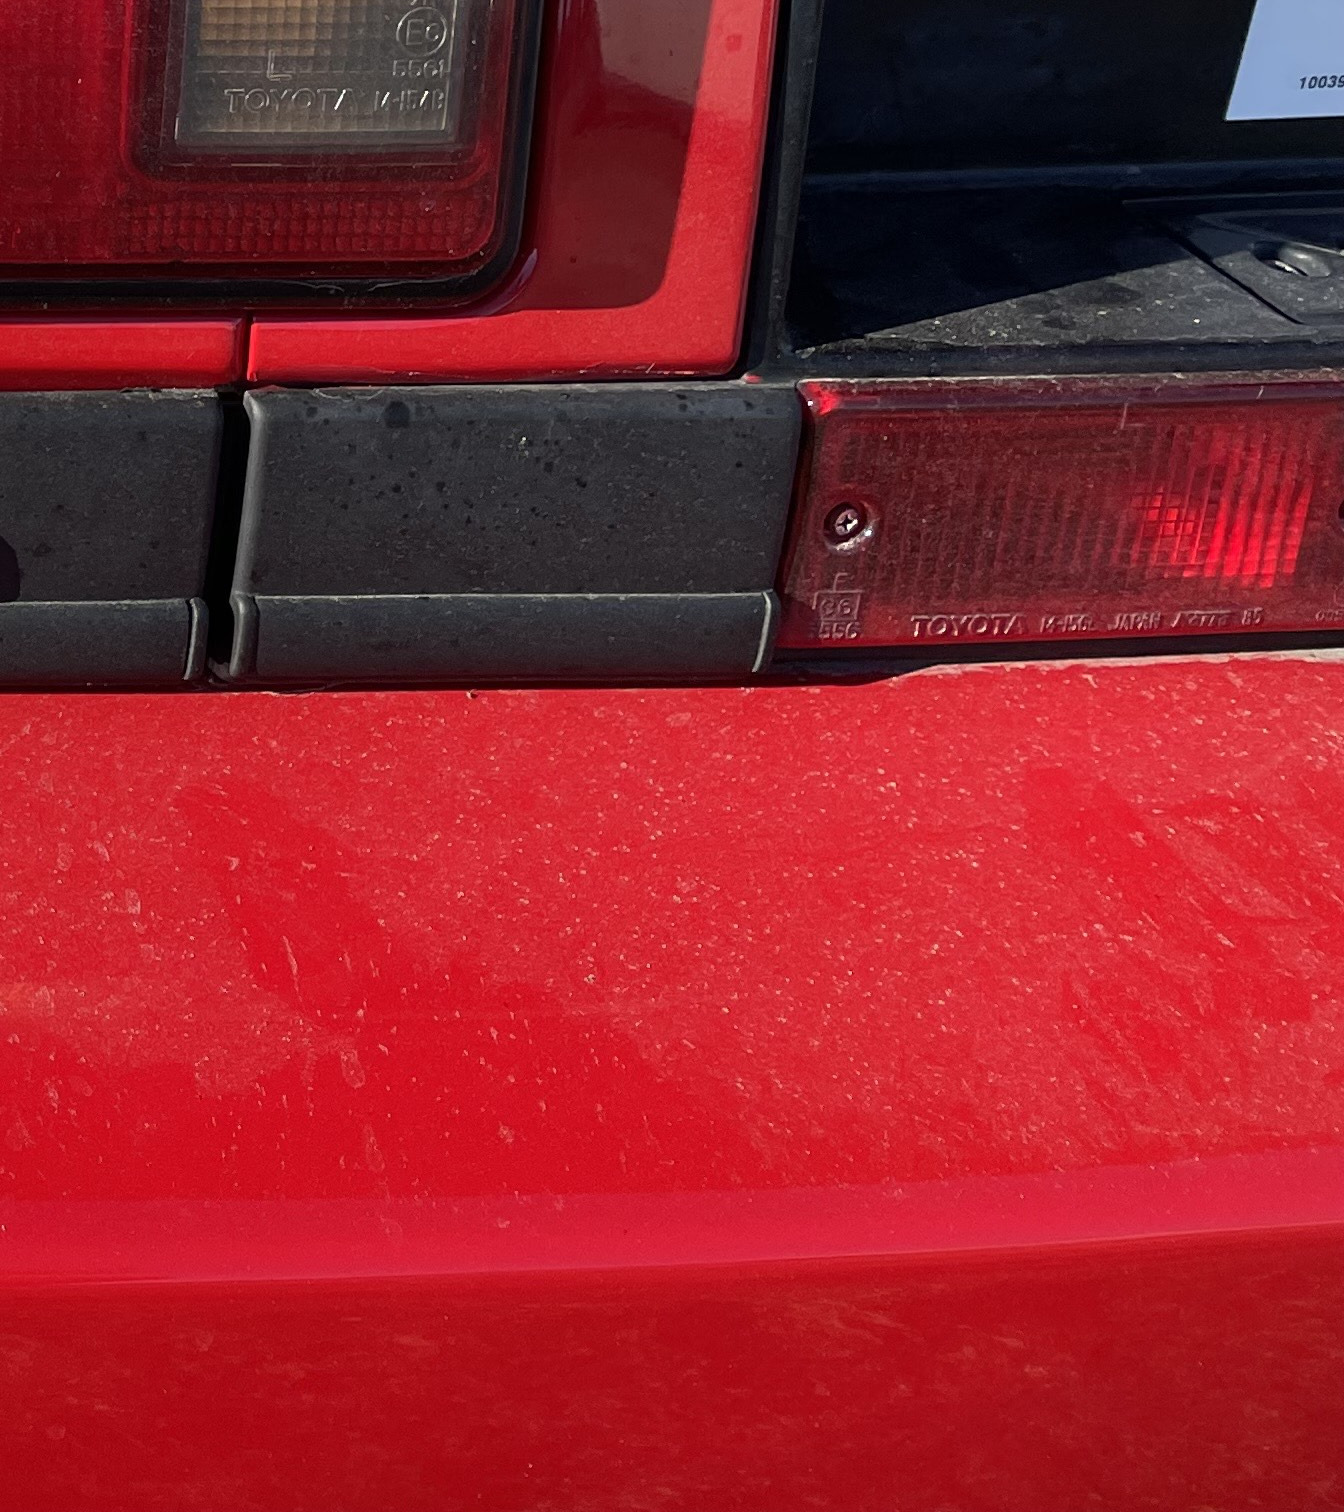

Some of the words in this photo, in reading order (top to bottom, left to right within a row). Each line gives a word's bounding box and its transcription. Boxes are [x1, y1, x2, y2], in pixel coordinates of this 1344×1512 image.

[266, 48, 293, 82] L
[223, 87, 361, 114] TOYOTA
[910, 613, 1028, 638] TOYOTA
